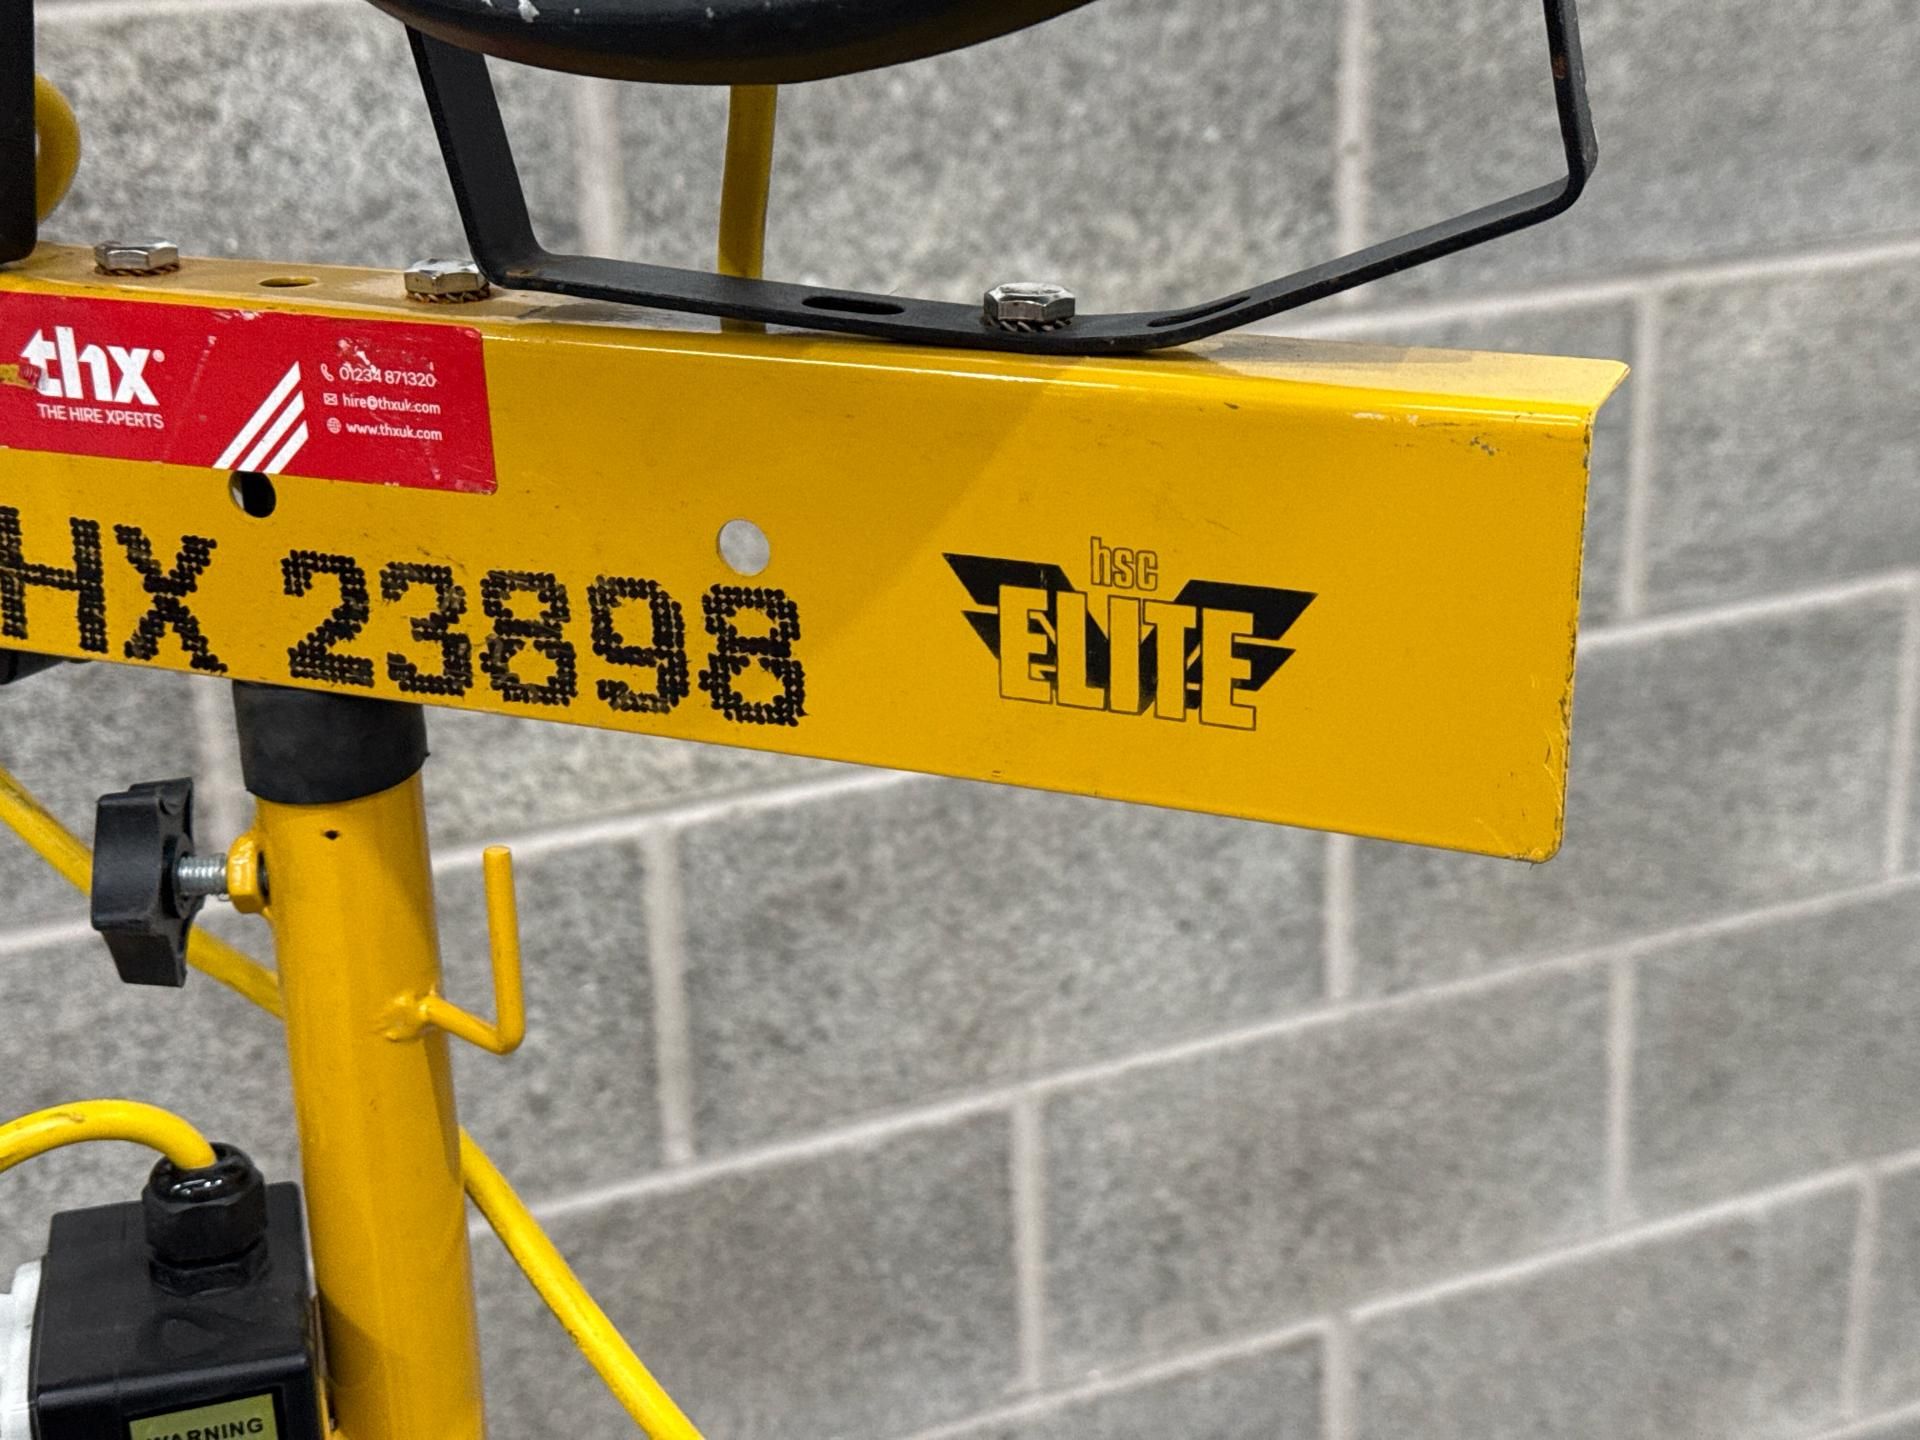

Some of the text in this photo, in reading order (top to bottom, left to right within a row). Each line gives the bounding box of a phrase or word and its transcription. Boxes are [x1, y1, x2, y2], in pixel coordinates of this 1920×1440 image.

[20, 325, 160, 406] thx
[339, 362, 437, 388] 01234 871320
[36, 403, 165, 430] THE HIRE XPERTS
[342, 392, 441, 415] hire@thxuk.com
[345, 422, 443, 441] www.thxuk.com
[1090, 536, 1158, 591] hsc
[281, 549, 806, 727] 23898
[999, 585, 1257, 731] ELITE
